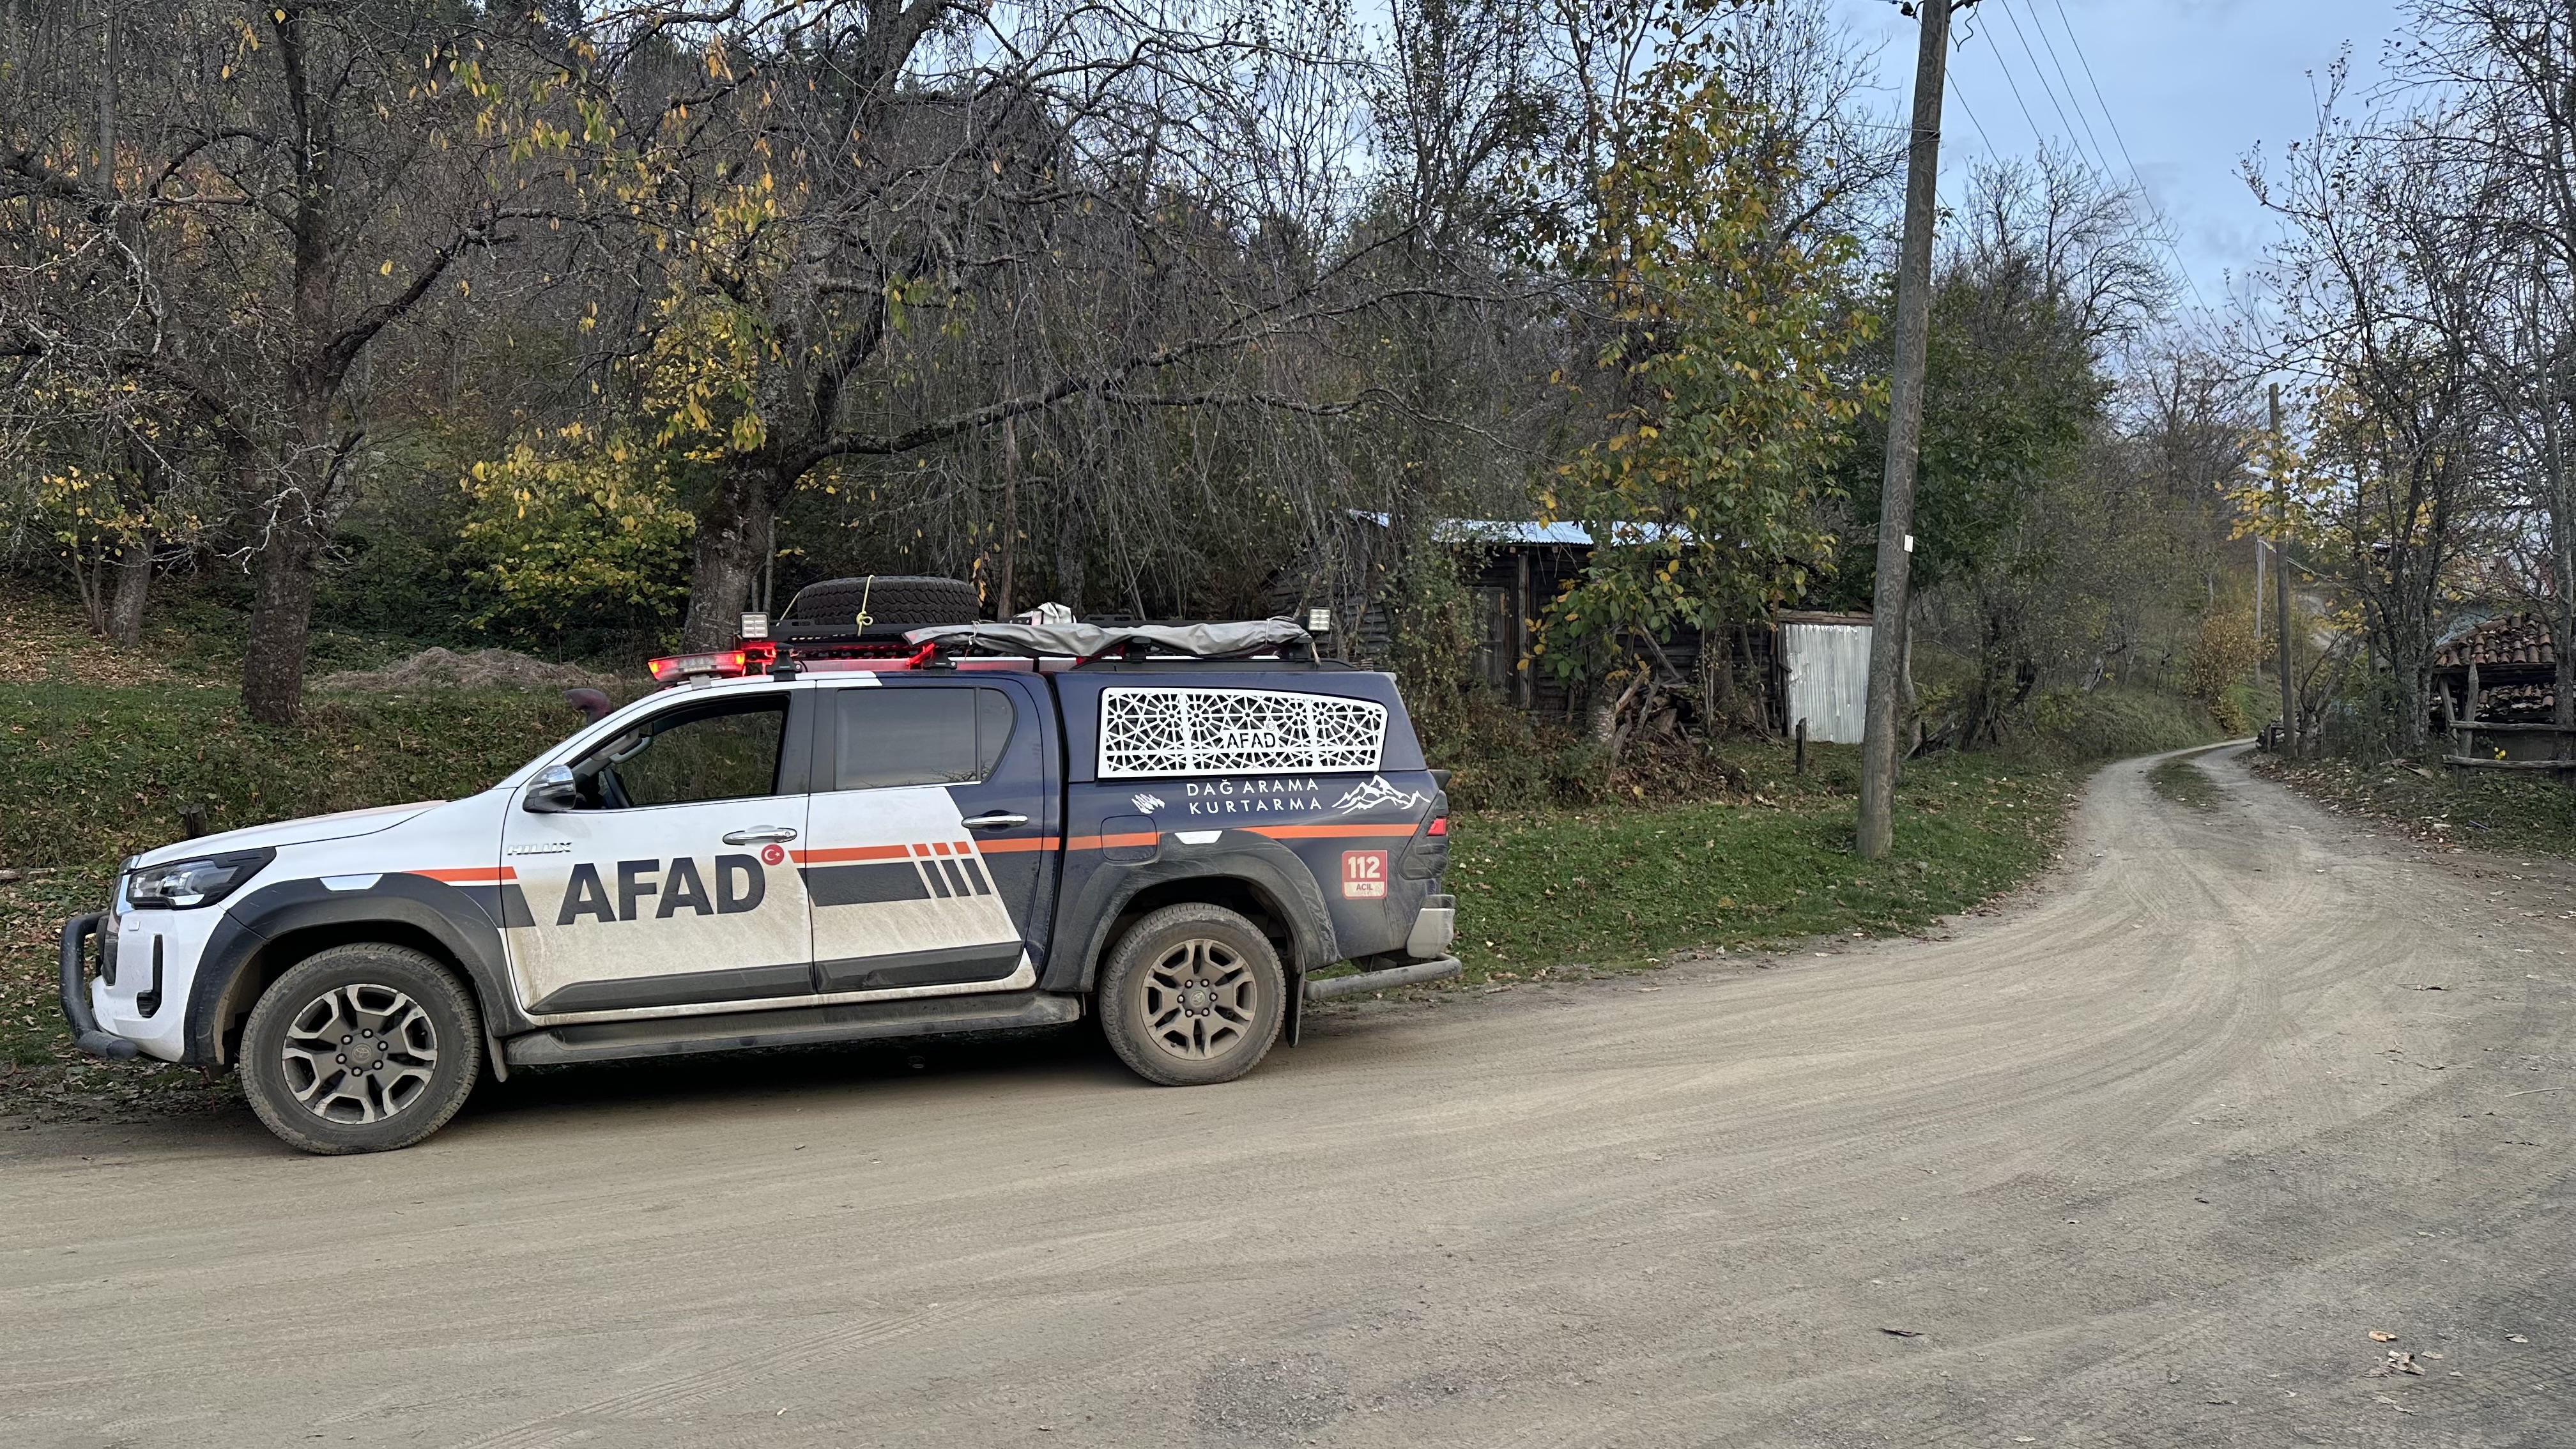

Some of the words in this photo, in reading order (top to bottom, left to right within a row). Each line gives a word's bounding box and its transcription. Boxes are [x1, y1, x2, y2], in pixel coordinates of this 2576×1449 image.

[1227, 732, 1276, 748] AFAD
[1186, 779, 1233, 797] DAĞ
[1243, 778, 1319, 793] ARAMA
[1189, 797, 1322, 815] KURTARMA
[507, 842, 572, 855] HILUX
[1348, 856, 1380, 878] 112
[556, 854, 765, 926] AFAD
